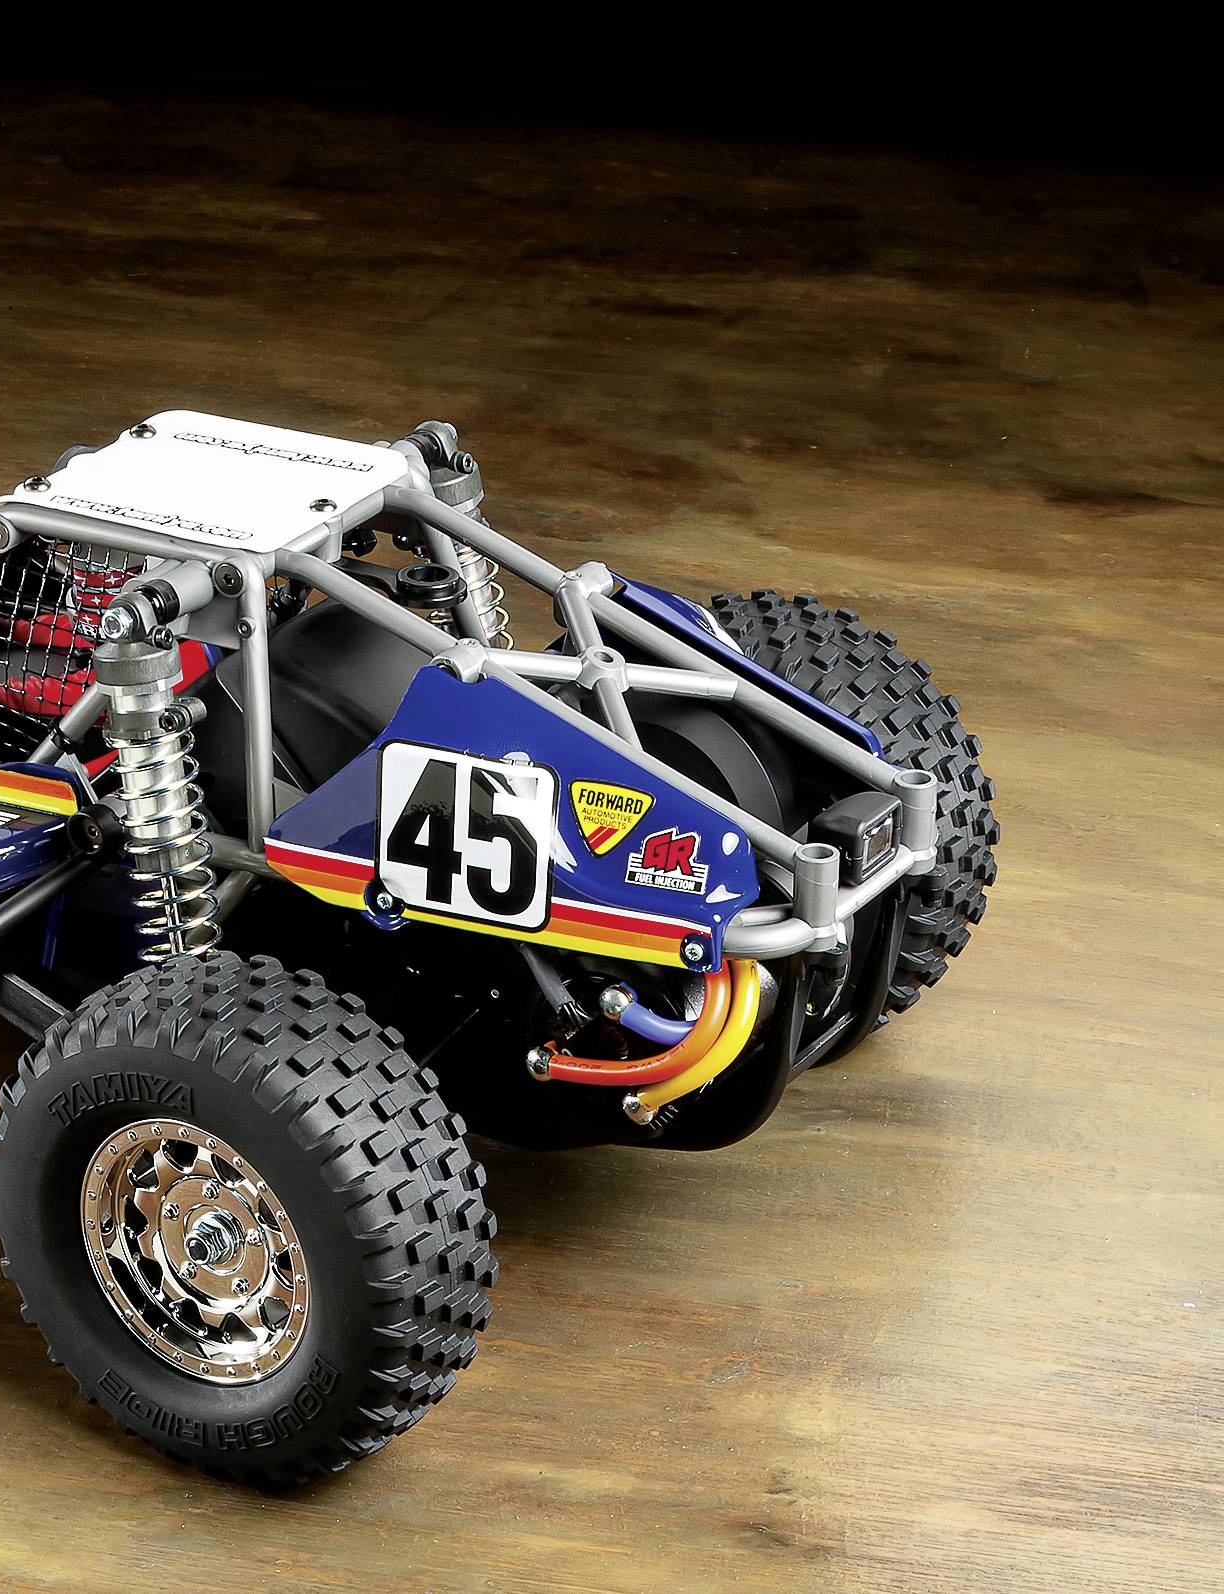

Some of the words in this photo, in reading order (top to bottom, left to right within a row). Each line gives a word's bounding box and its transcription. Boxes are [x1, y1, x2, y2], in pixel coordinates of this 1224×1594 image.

[577, 788, 644, 815] FORWARD
[581, 807, 633, 824] AUTOMOTIVE
[385, 757, 539, 918] 45
[582, 815, 627, 830] PRODUCTS
[634, 872, 654, 885] FUEL
[655, 875, 696, 891] INJECTION
[47, 1072, 196, 1128] TAMIYA
[98, 1367, 211, 1450] RIDE
[215, 1354, 343, 1451] ROUGH
